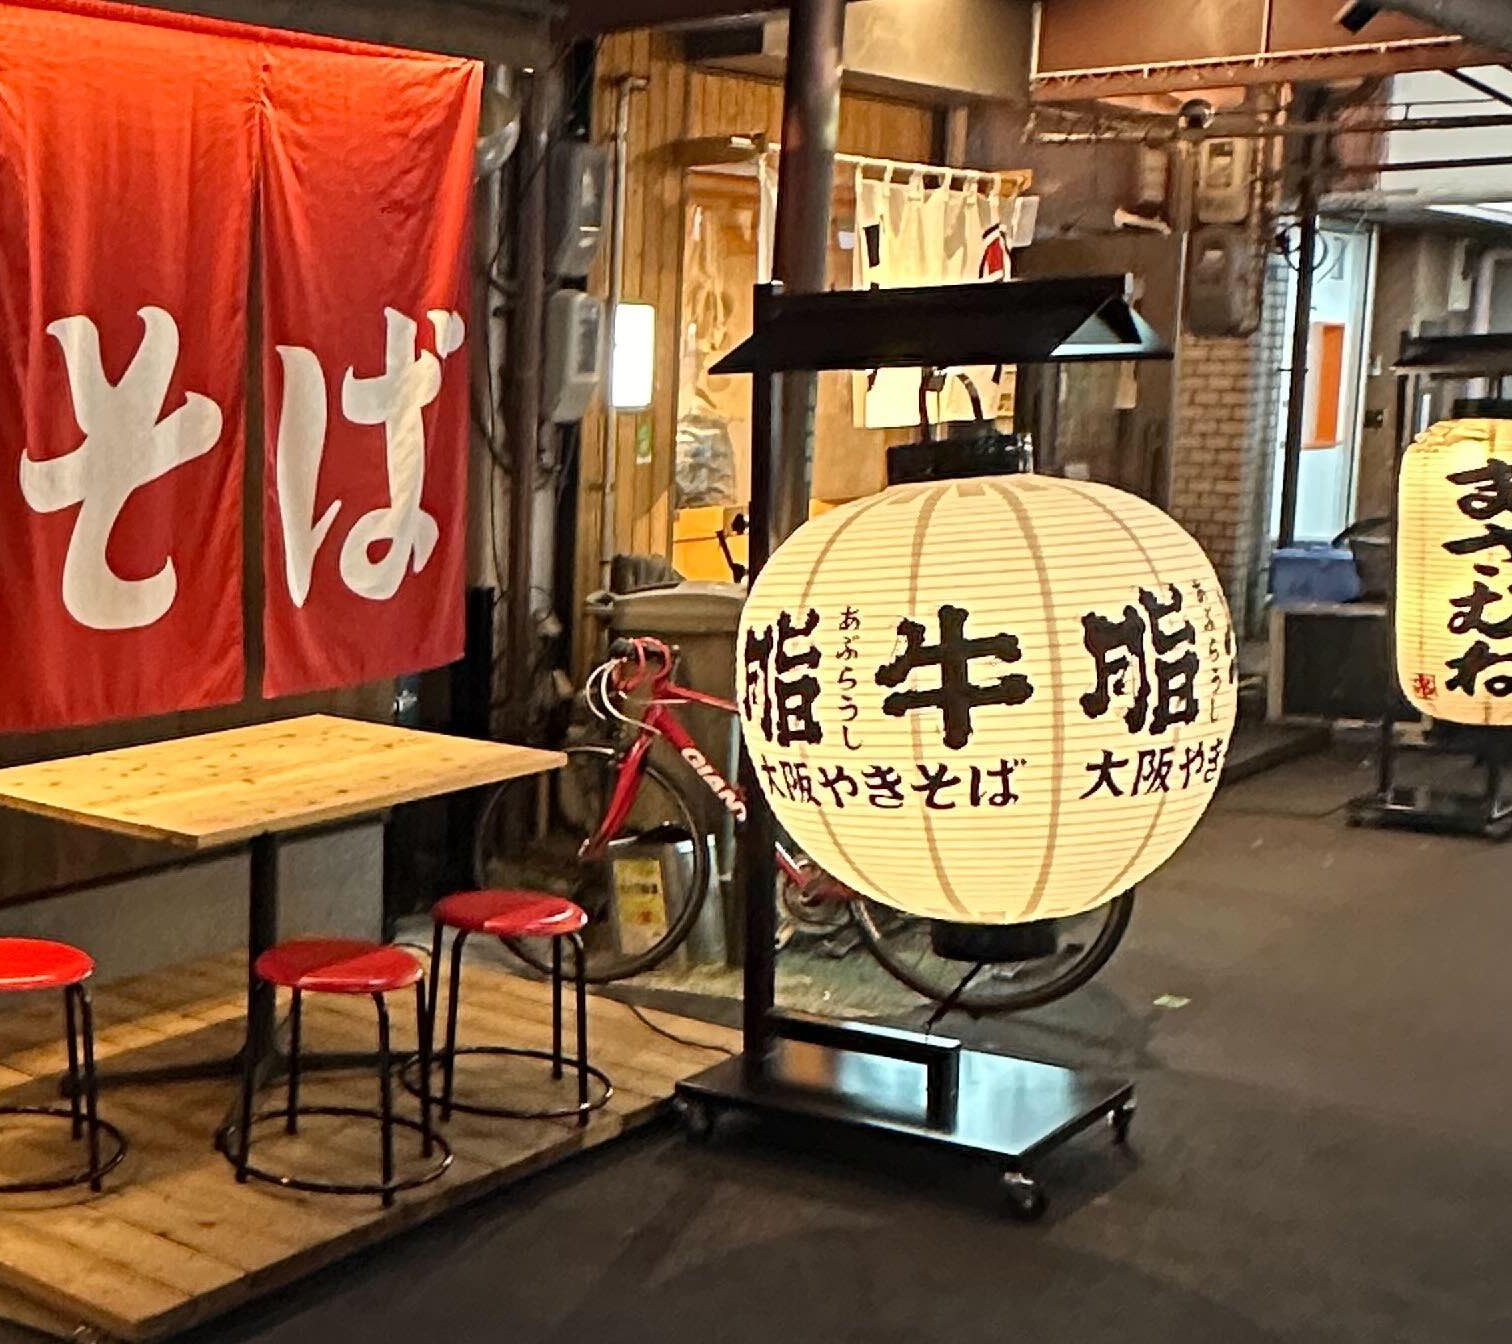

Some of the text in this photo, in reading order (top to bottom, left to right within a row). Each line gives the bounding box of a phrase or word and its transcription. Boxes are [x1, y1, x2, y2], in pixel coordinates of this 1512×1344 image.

[835, 606, 864, 751] あぶらうし
[681, 746, 747, 823] GIAN
[761, 754, 1028, 810] 大阪やきそば
